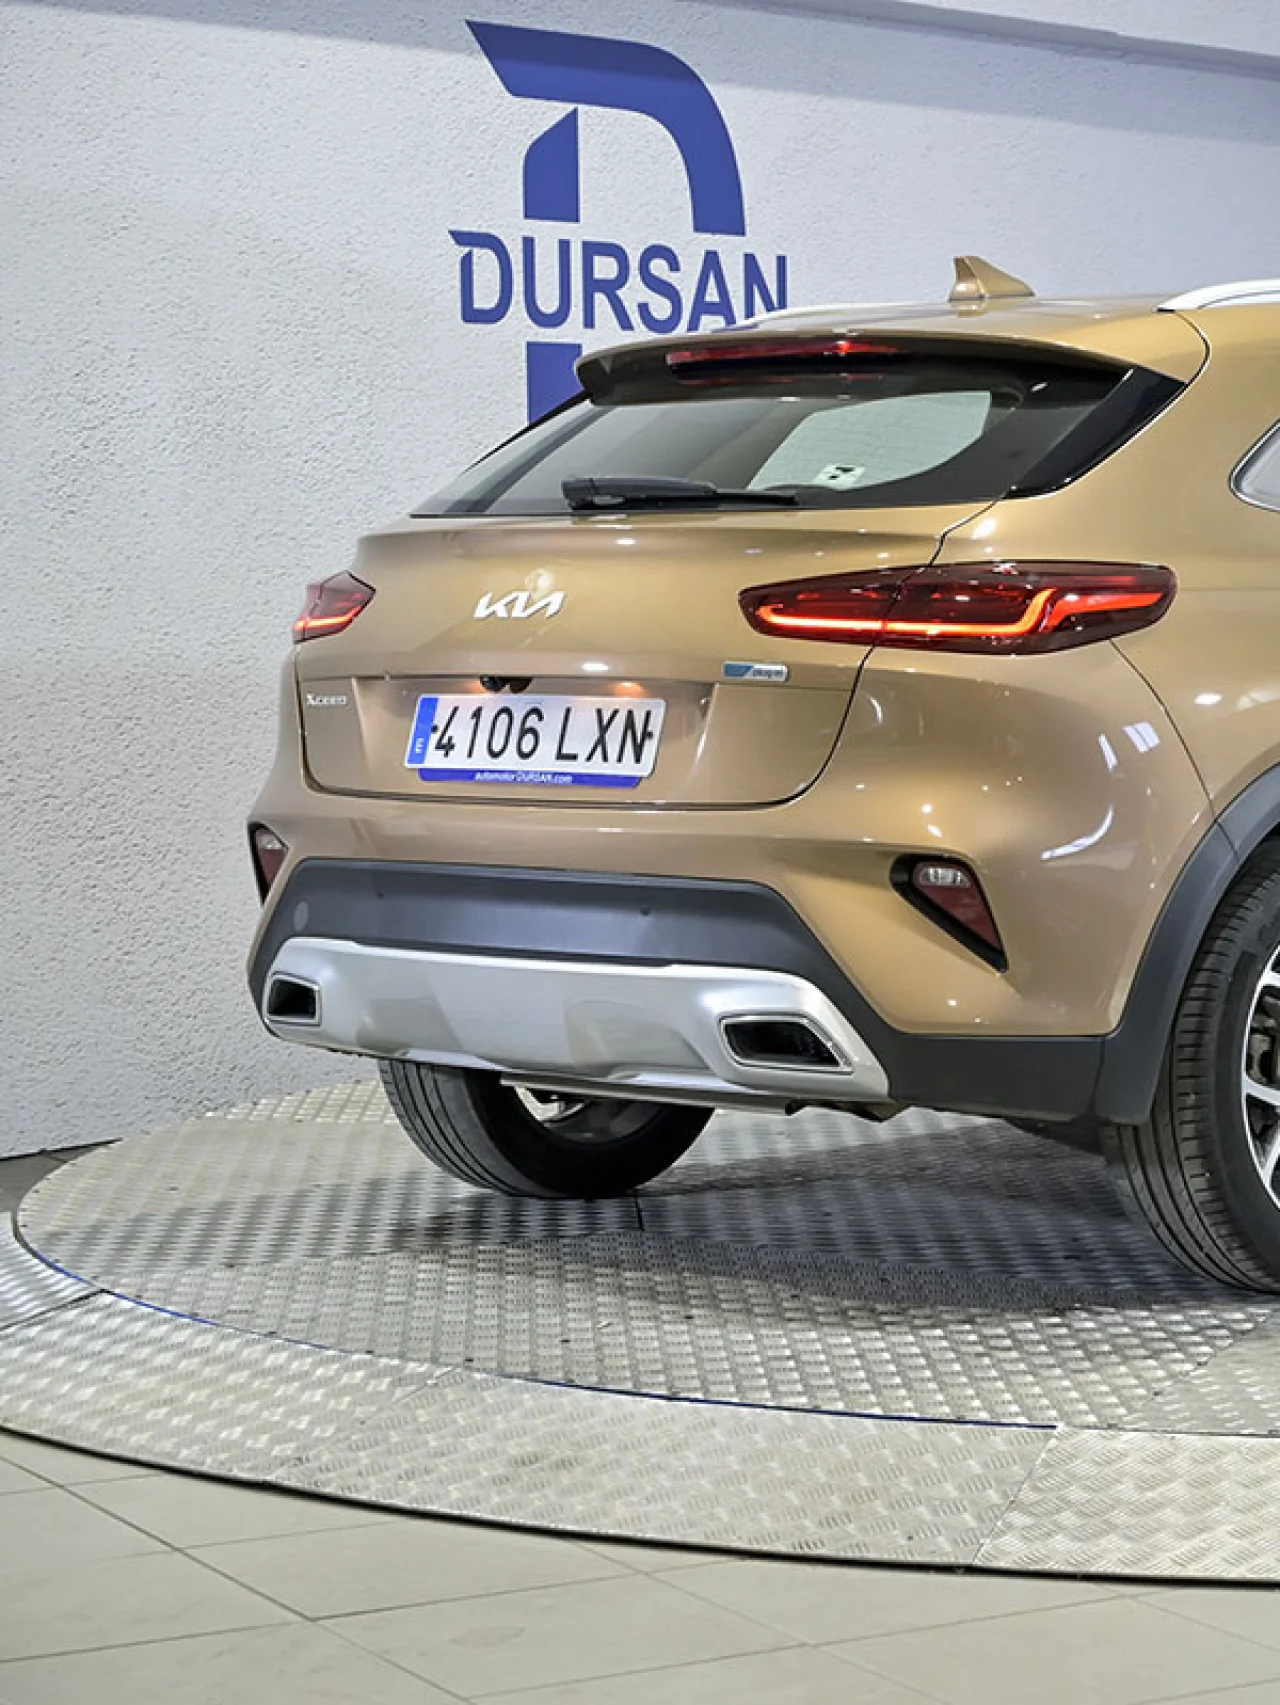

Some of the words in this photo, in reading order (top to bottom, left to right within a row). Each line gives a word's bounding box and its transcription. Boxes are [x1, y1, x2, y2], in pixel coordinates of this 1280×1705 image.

[448, 229, 788, 334] DURSAN
[473, 590, 566, 619] KIA
[434, 705, 545, 760] 4106
[555, 706, 652, 764] LXN
